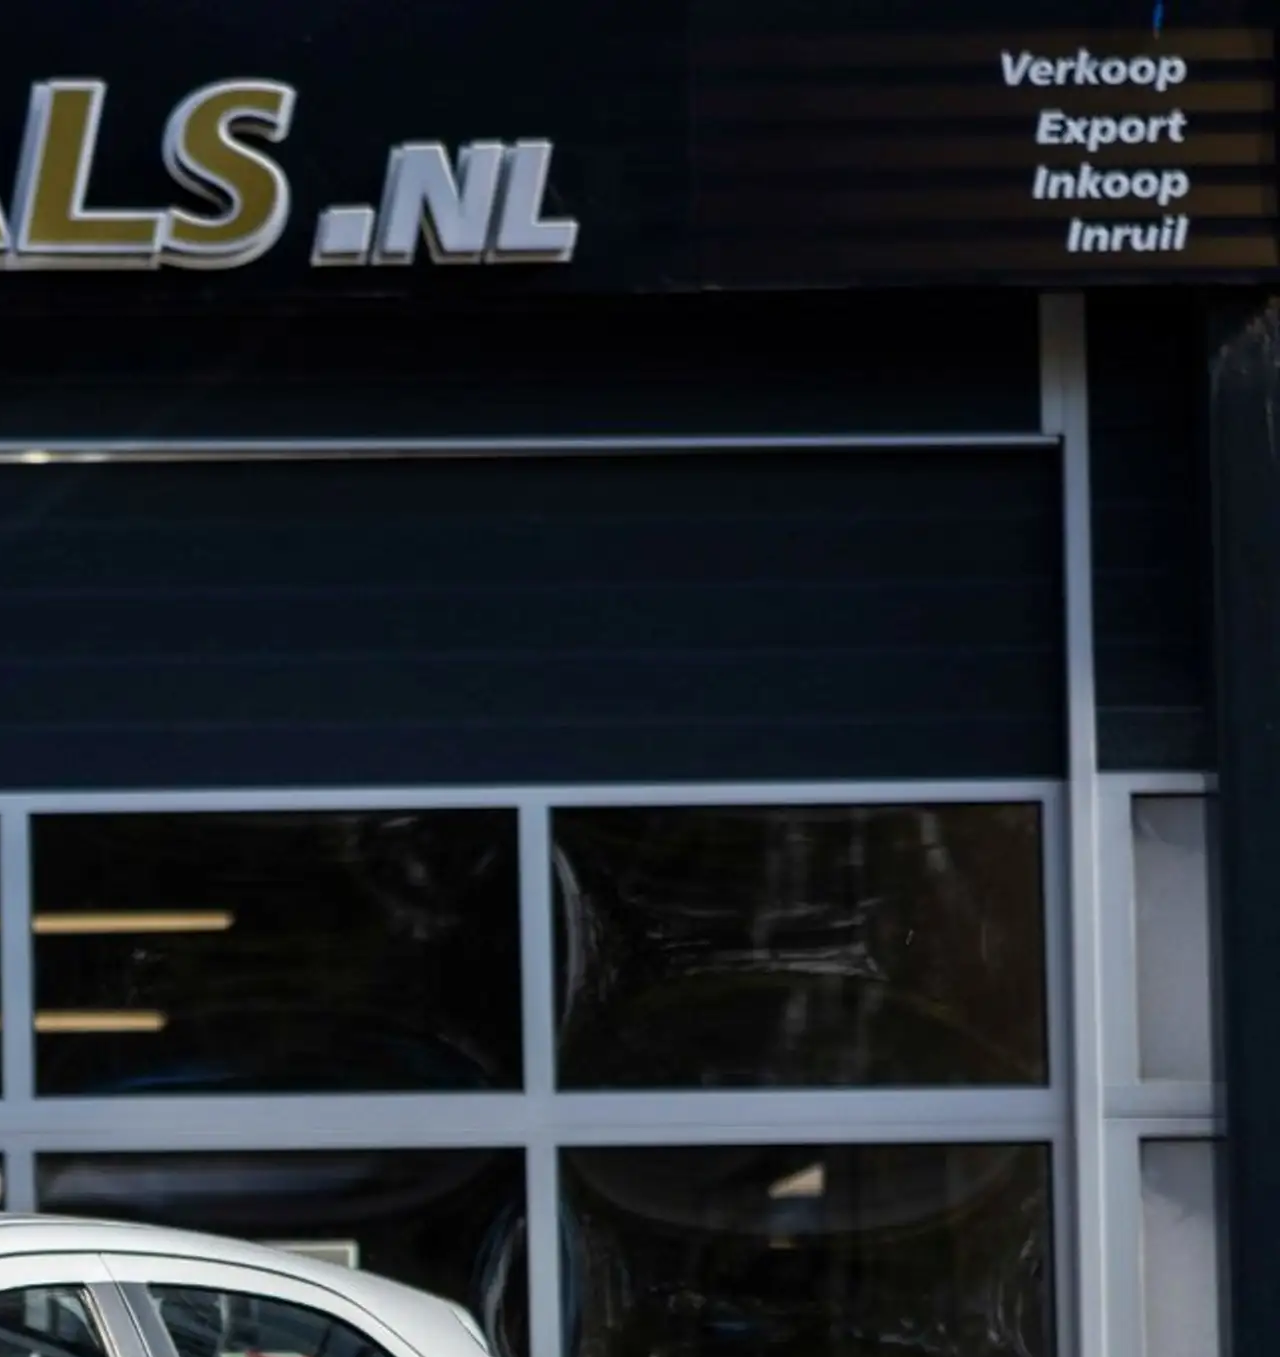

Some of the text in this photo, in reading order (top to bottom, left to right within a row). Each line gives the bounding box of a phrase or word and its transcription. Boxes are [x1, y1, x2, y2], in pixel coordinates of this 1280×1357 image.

[1001, 48, 1188, 92] Verkoop
[1036, 107, 1188, 152] Export
[1032, 161, 1189, 206] Inkoop
[1066, 213, 1189, 252] Inruil
